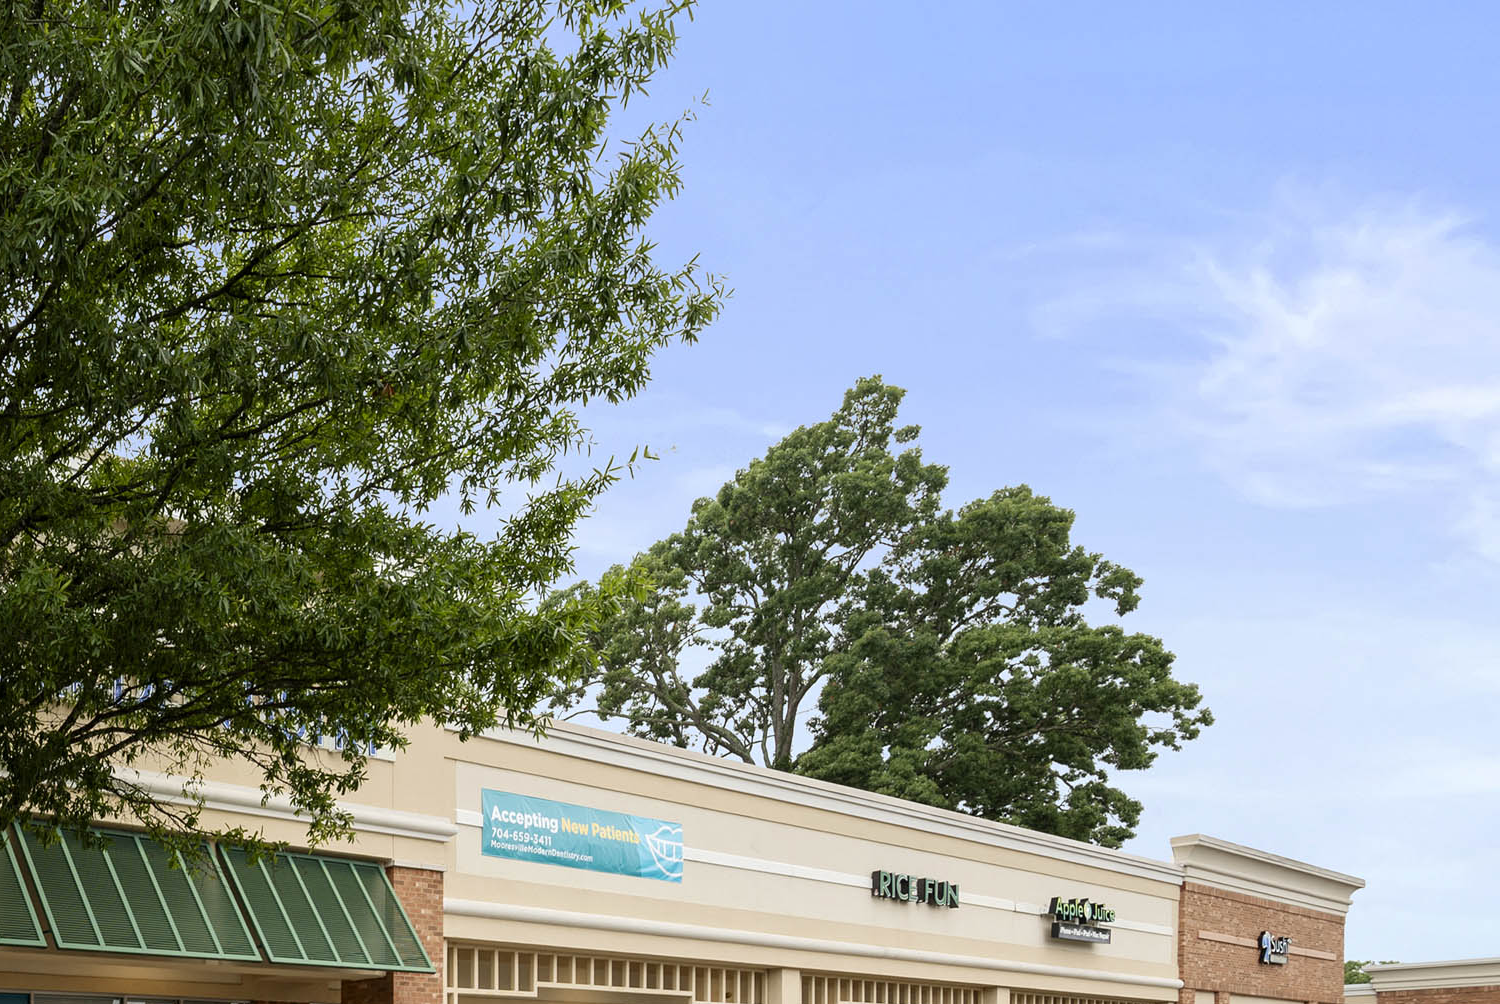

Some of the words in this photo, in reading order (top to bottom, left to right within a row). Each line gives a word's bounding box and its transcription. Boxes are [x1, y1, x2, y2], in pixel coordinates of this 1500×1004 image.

[491, 805, 559, 833] Accepting
[561, 816, 589, 836] New
[591, 821, 640, 844] Patients
[491, 827, 552, 846] 704-659-3411
[878, 870, 919, 902] RICE
[924, 877, 959, 907] FUN
[1055, 897, 1084, 920] Apple
[1092, 903, 1116, 922] Juice
